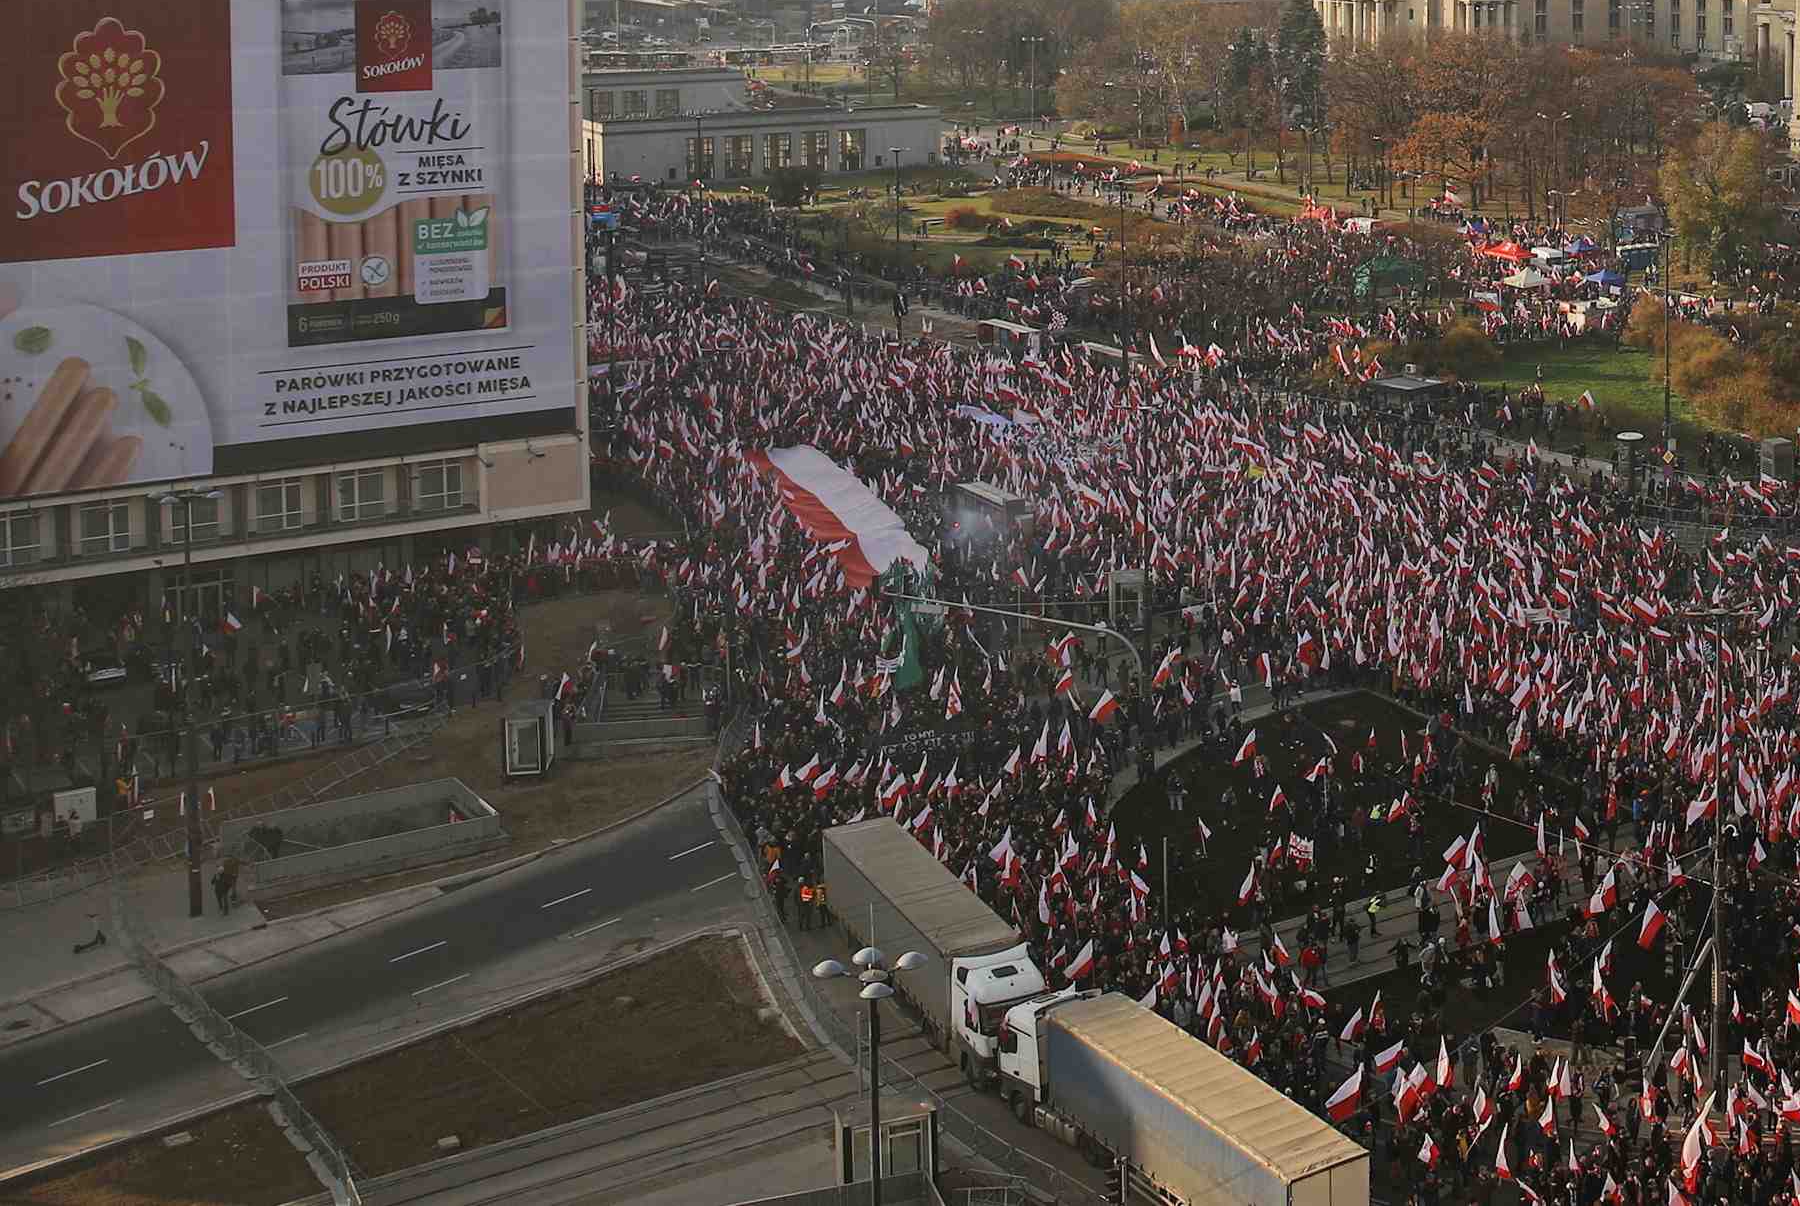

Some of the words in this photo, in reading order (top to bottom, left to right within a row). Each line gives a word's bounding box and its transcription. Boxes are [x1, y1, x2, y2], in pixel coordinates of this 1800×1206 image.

[363, 53, 425, 79] SOKOŁÓW
[320, 96, 472, 156] Stówki
[418, 154, 465, 170] MIĘSA
[16, 141, 209, 219] SOKOŁÓW
[316, 158, 383, 199] 100%
[398, 173, 411, 186] Z
[416, 168, 482, 185] SZYNKI
[418, 223, 455, 240] BEZ
[301, 262, 348, 274] PRODUKT
[300, 275, 350, 291] POLSKI
[275, 371, 364, 393] PARÓWKI
[370, 355, 521, 384] PRZYGOTOWANE
[264, 401, 277, 417] Z
[282, 391, 393, 416] NAJLEPSZEJ
[398, 380, 472, 405] JAKOŚCI
[477, 375, 531, 395] MIĘSA
